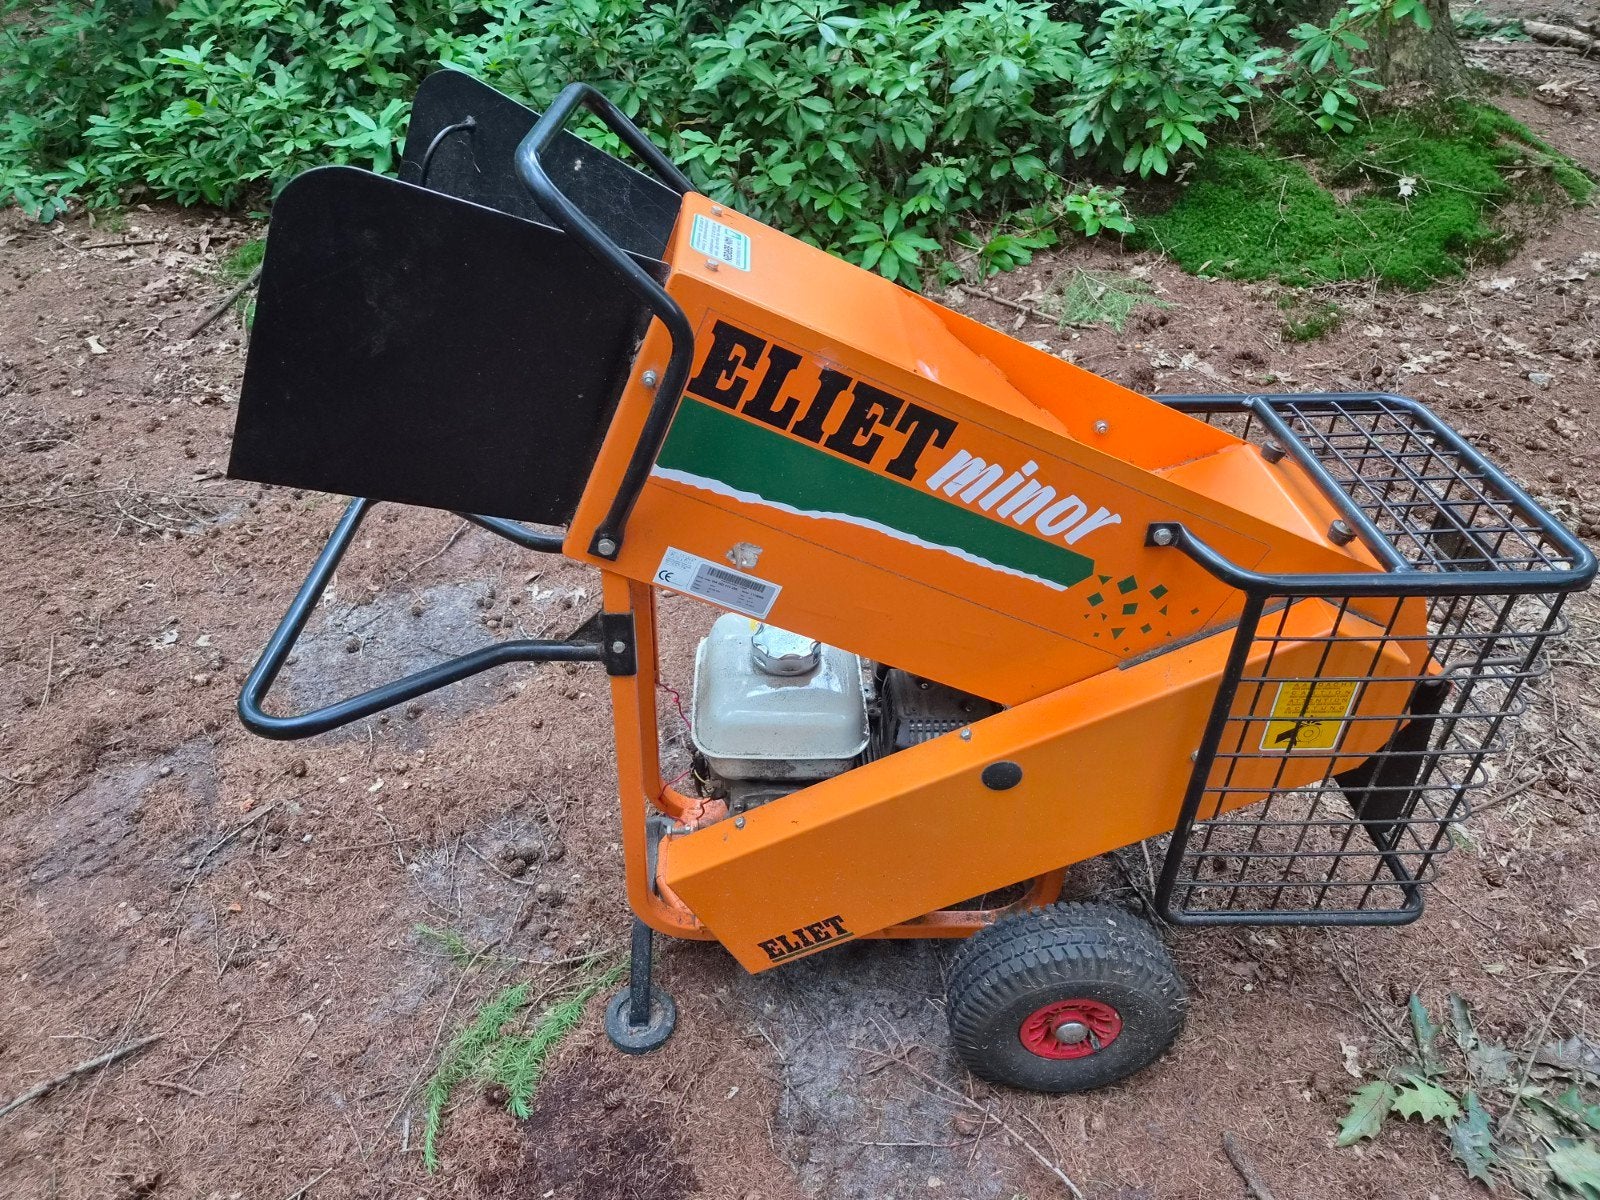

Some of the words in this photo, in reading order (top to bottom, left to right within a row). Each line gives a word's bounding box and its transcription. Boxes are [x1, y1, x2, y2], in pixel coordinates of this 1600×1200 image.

[687, 319, 958, 482] ELIET
[925, 448, 1122, 546] minor
[757, 915, 848, 960] ELIET
